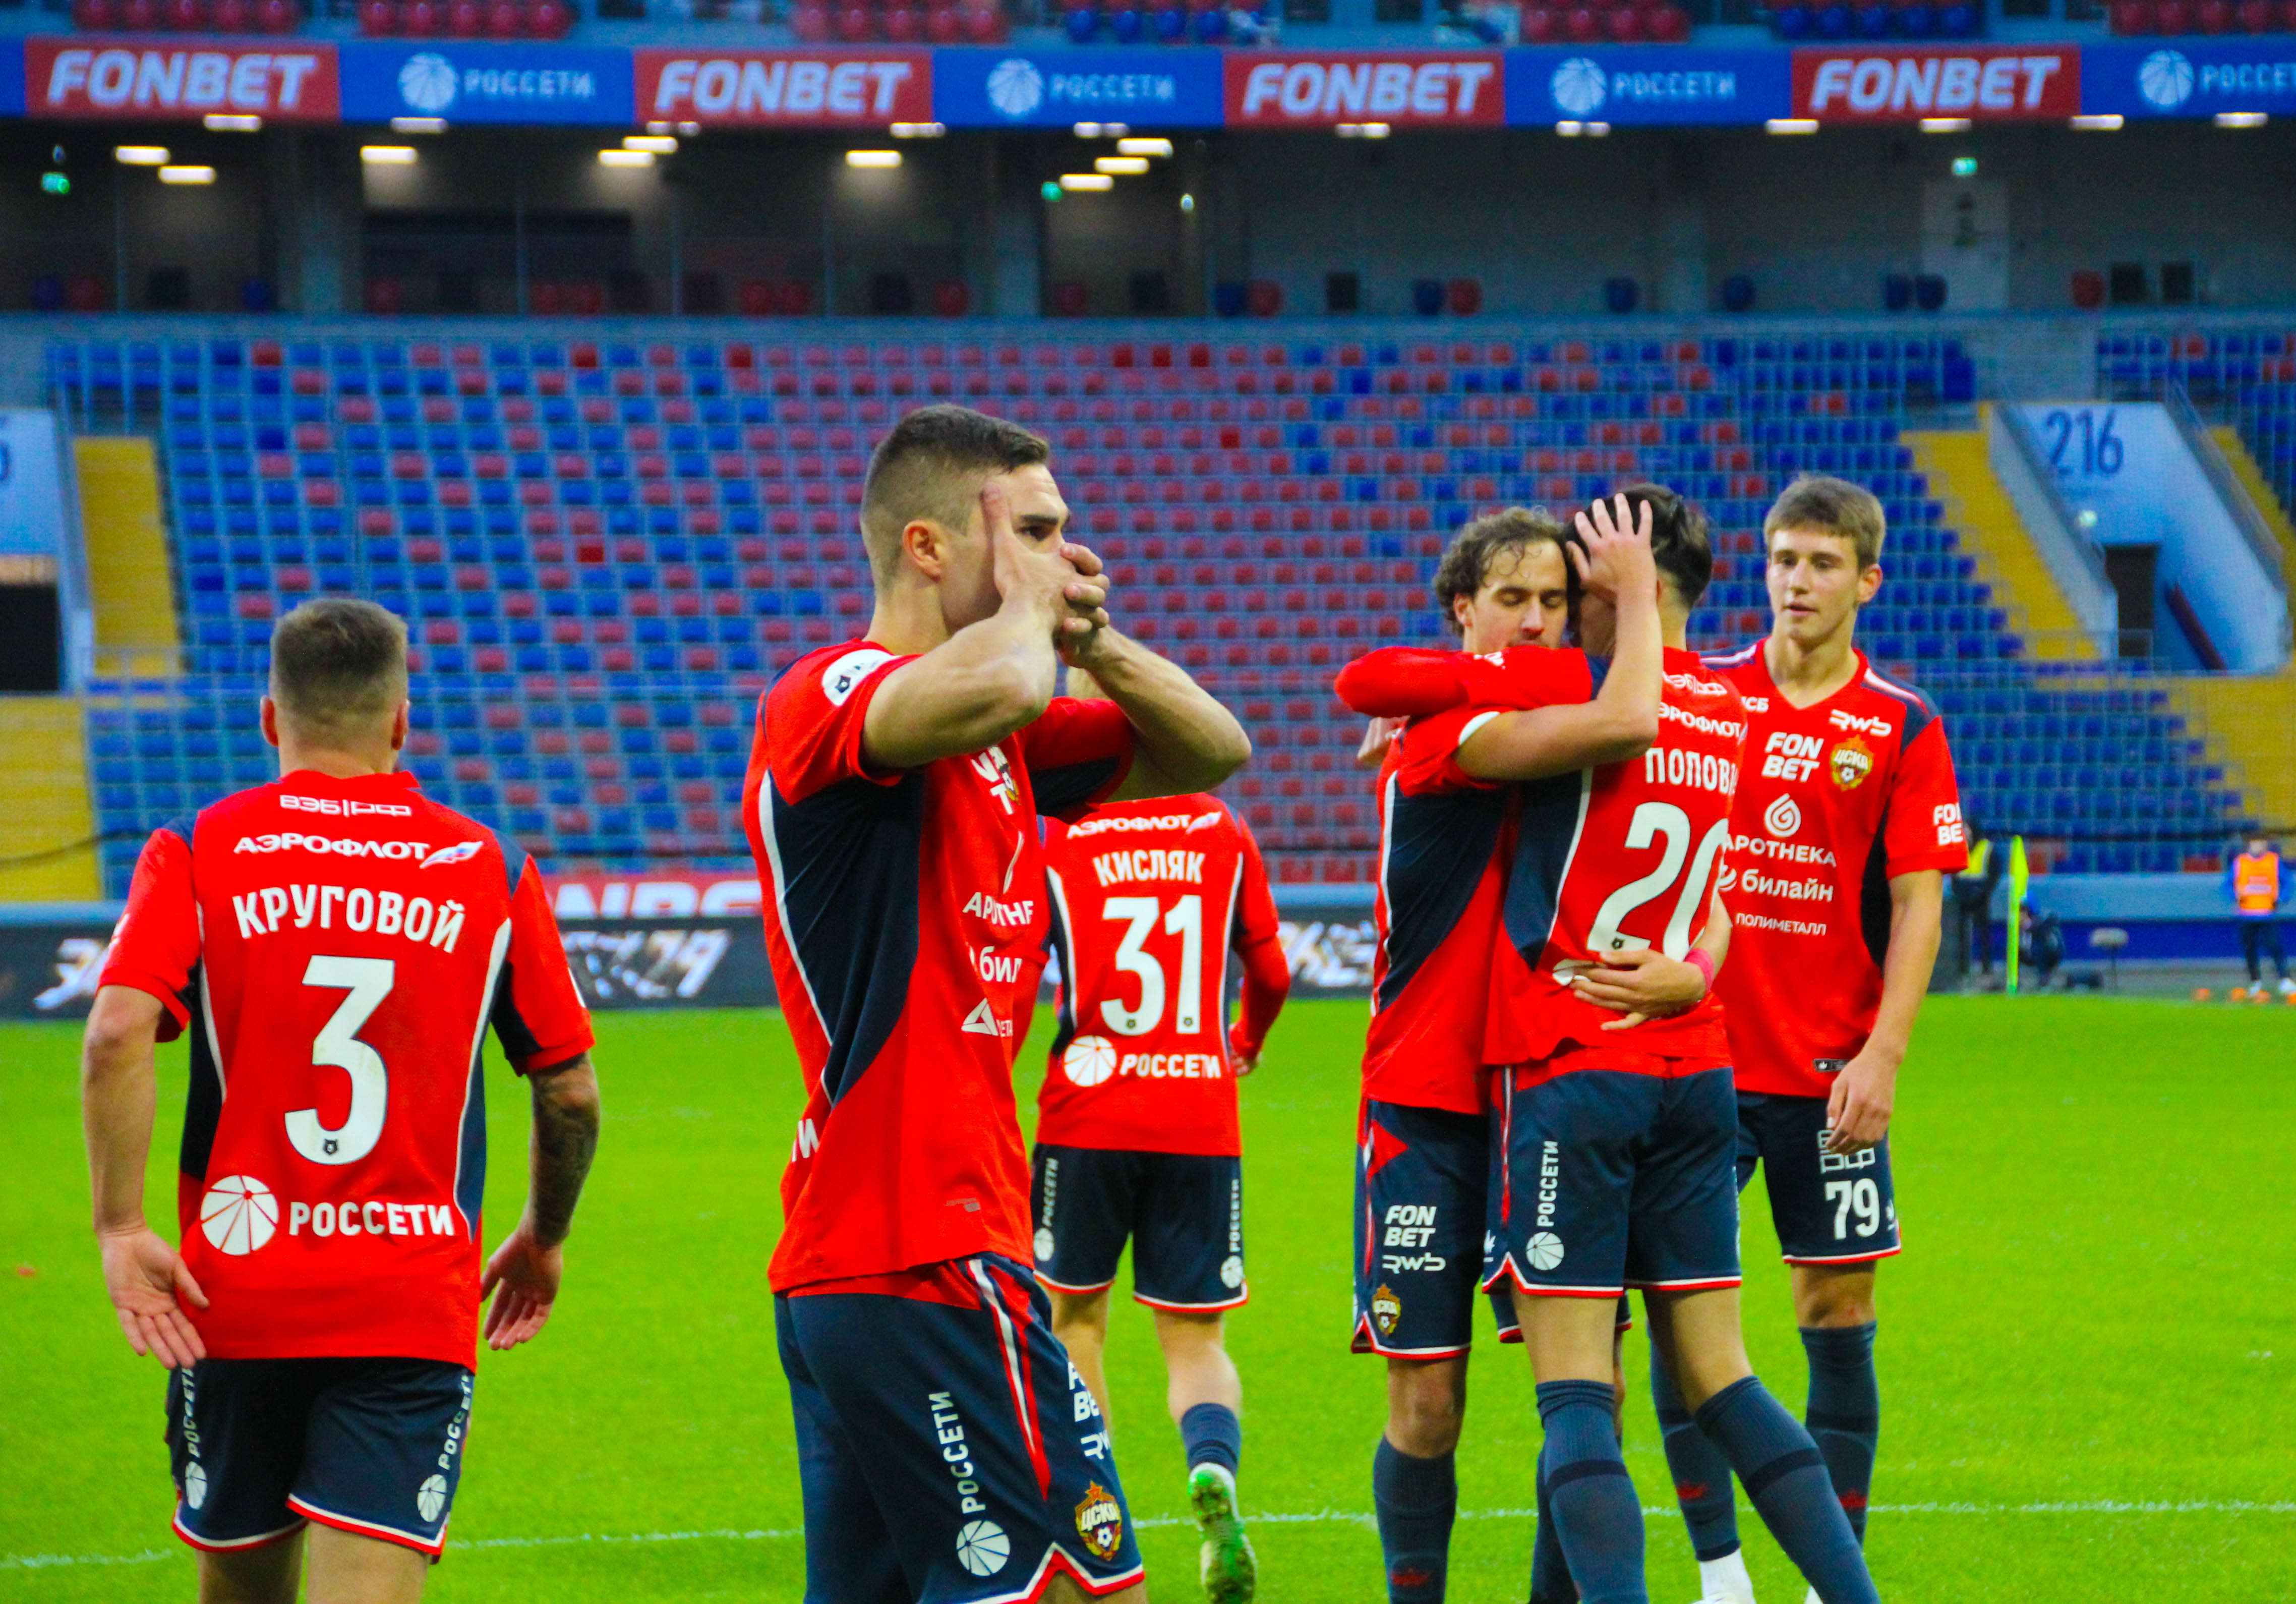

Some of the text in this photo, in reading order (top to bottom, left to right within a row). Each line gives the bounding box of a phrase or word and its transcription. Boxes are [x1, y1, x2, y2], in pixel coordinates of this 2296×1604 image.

[46, 49, 315, 108] FONBET
[464, 69, 594, 99] РОССЕТИ
[653, 60, 909, 115] FONBET
[1049, 72, 1176, 103] РОССЕТИ
[1242, 62, 1493, 116] FONBET
[1615, 71, 1736, 101] РОССЕТИ
[1809, 55, 2062, 111] FONBET
[2200, 63, 2296, 95] РОССЕТ
[2045, 408, 2124, 476] 216
[1659, 702, 1741, 738] ЭРОФЛОТ
[1765, 731, 1824, 760] FON
[1761, 755, 1820, 783] BET
[1067, 815, 1192, 838] АЭРОФЛОТ
[1937, 822, 1964, 846] BE
[233, 832, 431, 861] АЭРОФЛОТ
[1093, 850, 1205, 887] КИСЛЯК
[1742, 869, 1834, 902] билайн
[233, 884, 465, 953] КРУГОВОЙ
[1736, 912, 1827, 936] ПОЛИМЕТАЛЛ
[980, 945, 1023, 983] бил
[1100, 894, 1202, 1036] 31
[285, 955, 395, 1165] 3
[1537, 1140, 1558, 1228] РОССЕТИ
[289, 1201, 455, 1237] РОССЕТИ
[1384, 1206, 1437, 1226] FON
[1824, 1178, 1880, 1240] 79
[1384, 1227, 1436, 1247] BET
[929, 1391, 986, 1514] РОССЕТИ
